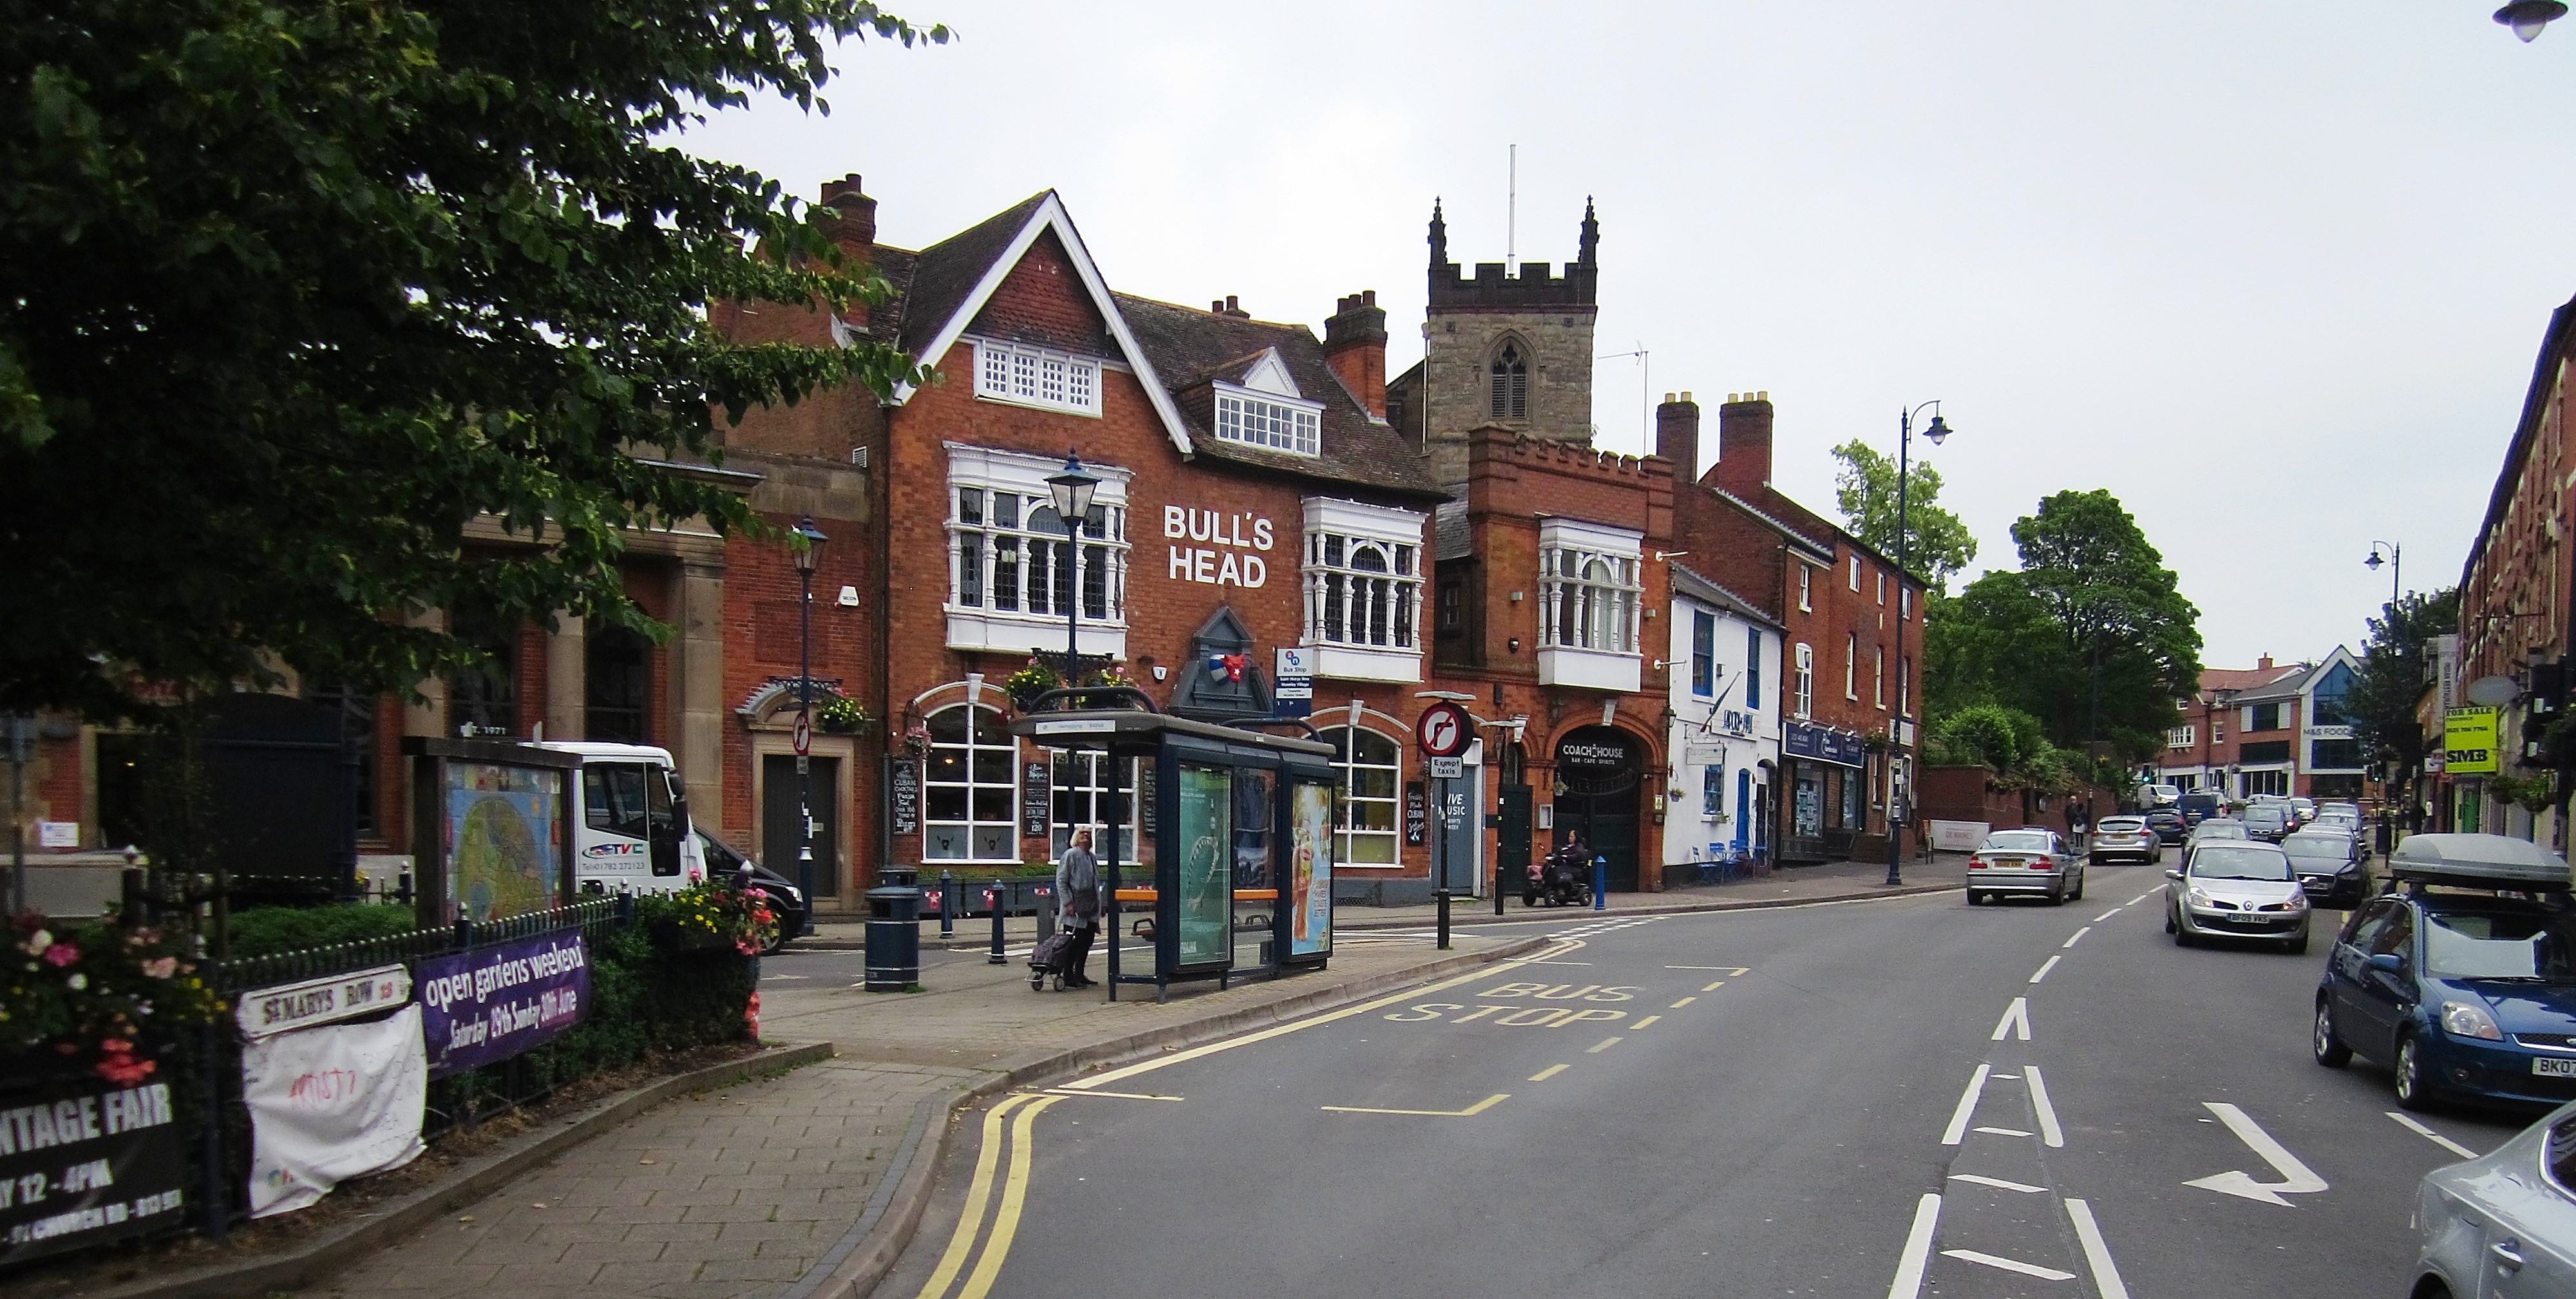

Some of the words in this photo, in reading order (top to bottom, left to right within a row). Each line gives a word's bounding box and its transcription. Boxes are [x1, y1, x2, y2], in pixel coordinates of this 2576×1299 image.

[1164, 504, 1274, 551] BULL'S
[1169, 545, 1267, 588] HEAD
[1563, 745, 1591, 756] COACH
[1597, 747, 1623, 758] HOUSE
[2447, 750, 2487, 763] SMB
[1447, 793, 1463, 804] IVE
[426, 972, 473, 1013] open
[475, 954, 529, 1003] gardens
[528, 936, 584, 980] weekend
[346, 981, 374, 1007] ROW
[1477, 982, 1641, 1001] BUS
[449, 1013, 489, 1051] Saturday
[490, 1003, 512, 1038] 29th
[512, 997, 541, 1030] Sunday
[558, 988, 578, 1016] June
[1383, 1003, 1628, 1028] STOP
[103, 1083, 173, 1135] FAIR
[17, 1173, 48, 1204] 12
